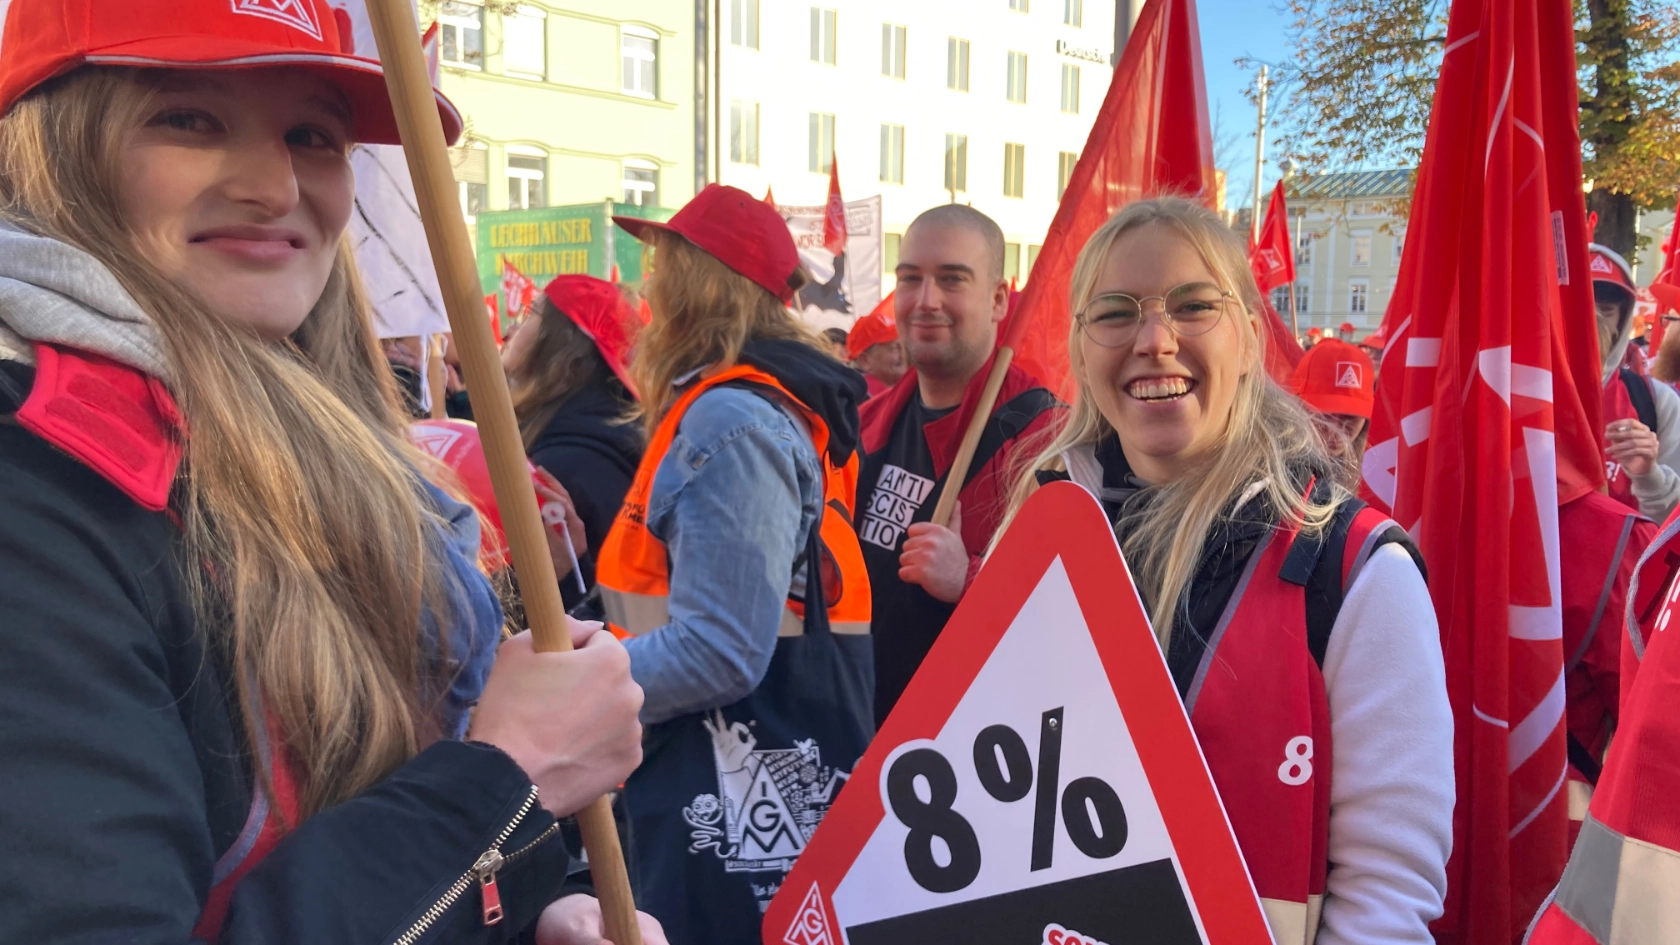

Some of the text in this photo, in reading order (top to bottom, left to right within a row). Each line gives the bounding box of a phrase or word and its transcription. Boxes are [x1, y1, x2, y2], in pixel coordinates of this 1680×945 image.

[880, 468, 924, 502] ANTI
[1277, 735, 1313, 786] 8
[887, 705, 1128, 894] 8%
